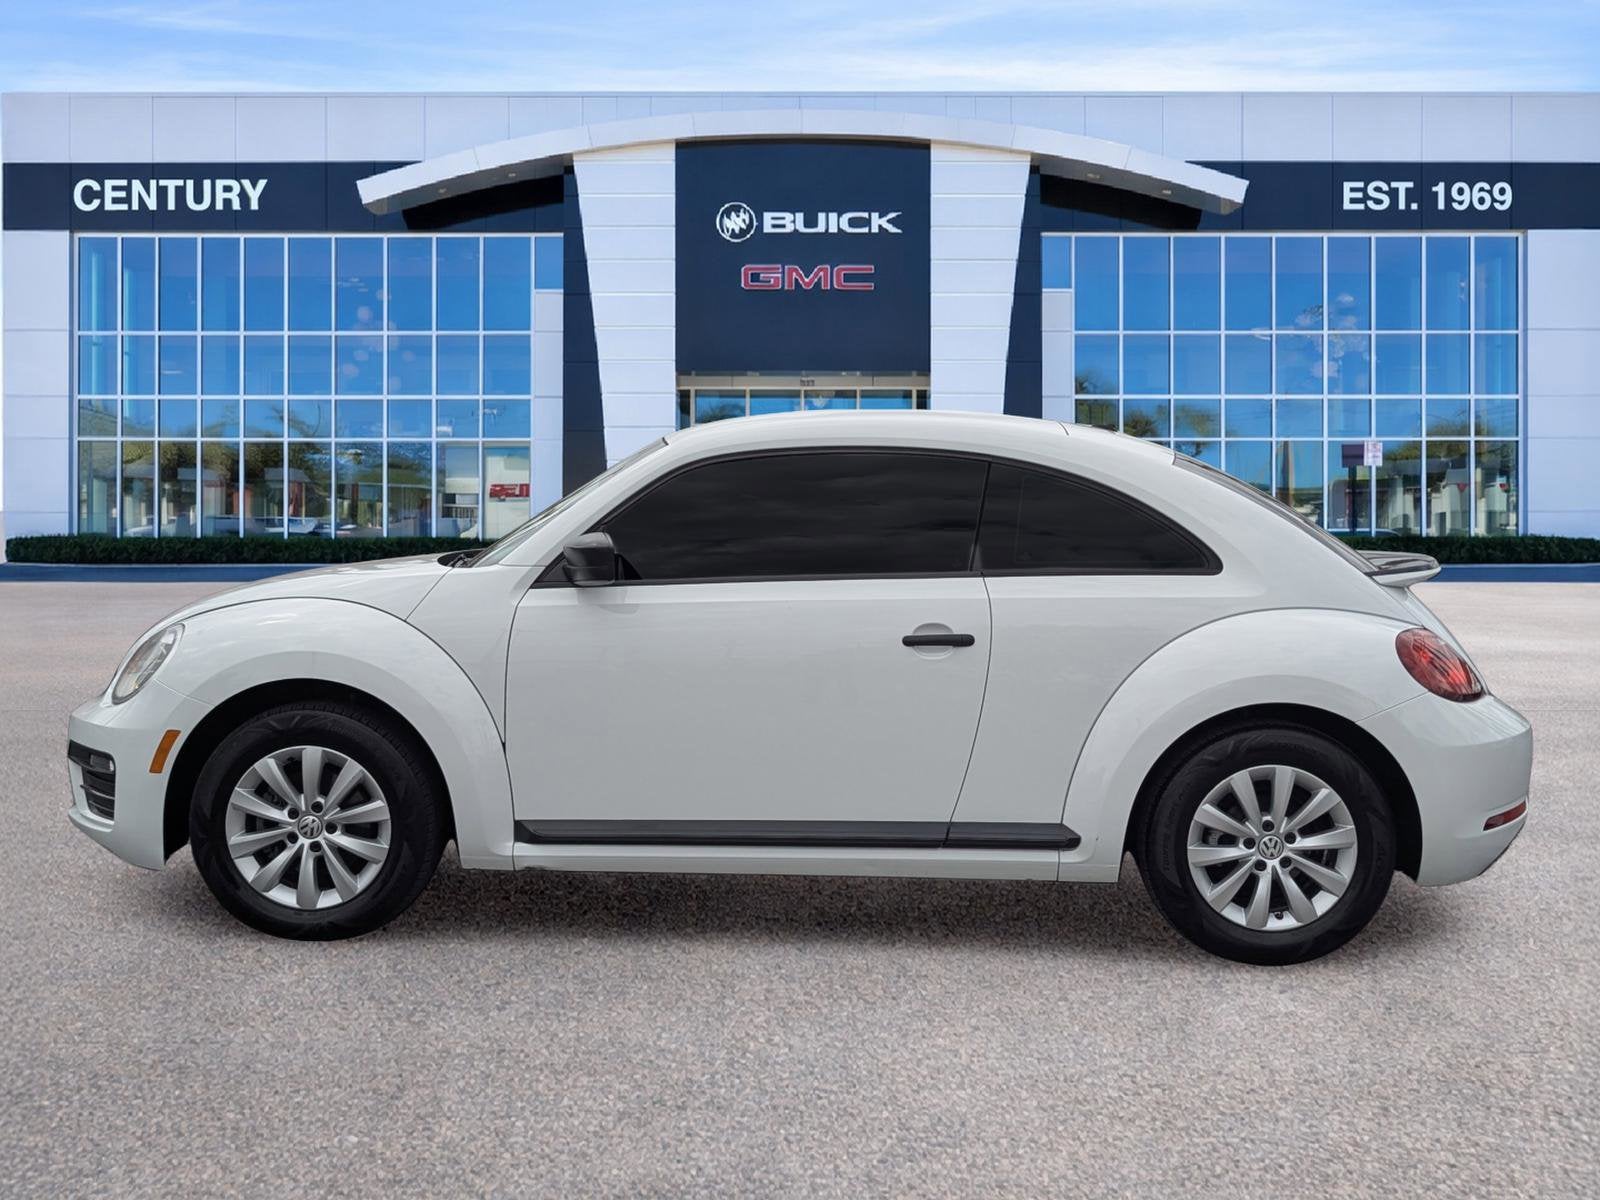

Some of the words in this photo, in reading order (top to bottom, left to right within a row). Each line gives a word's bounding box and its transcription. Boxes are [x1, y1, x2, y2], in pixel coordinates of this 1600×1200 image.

[74, 179, 268, 212] CENTURY
[1343, 181, 1418, 211] EST.
[1432, 181, 1513, 211] 1969
[763, 211, 903, 234] BUICK
[740, 264, 875, 291] GMC
